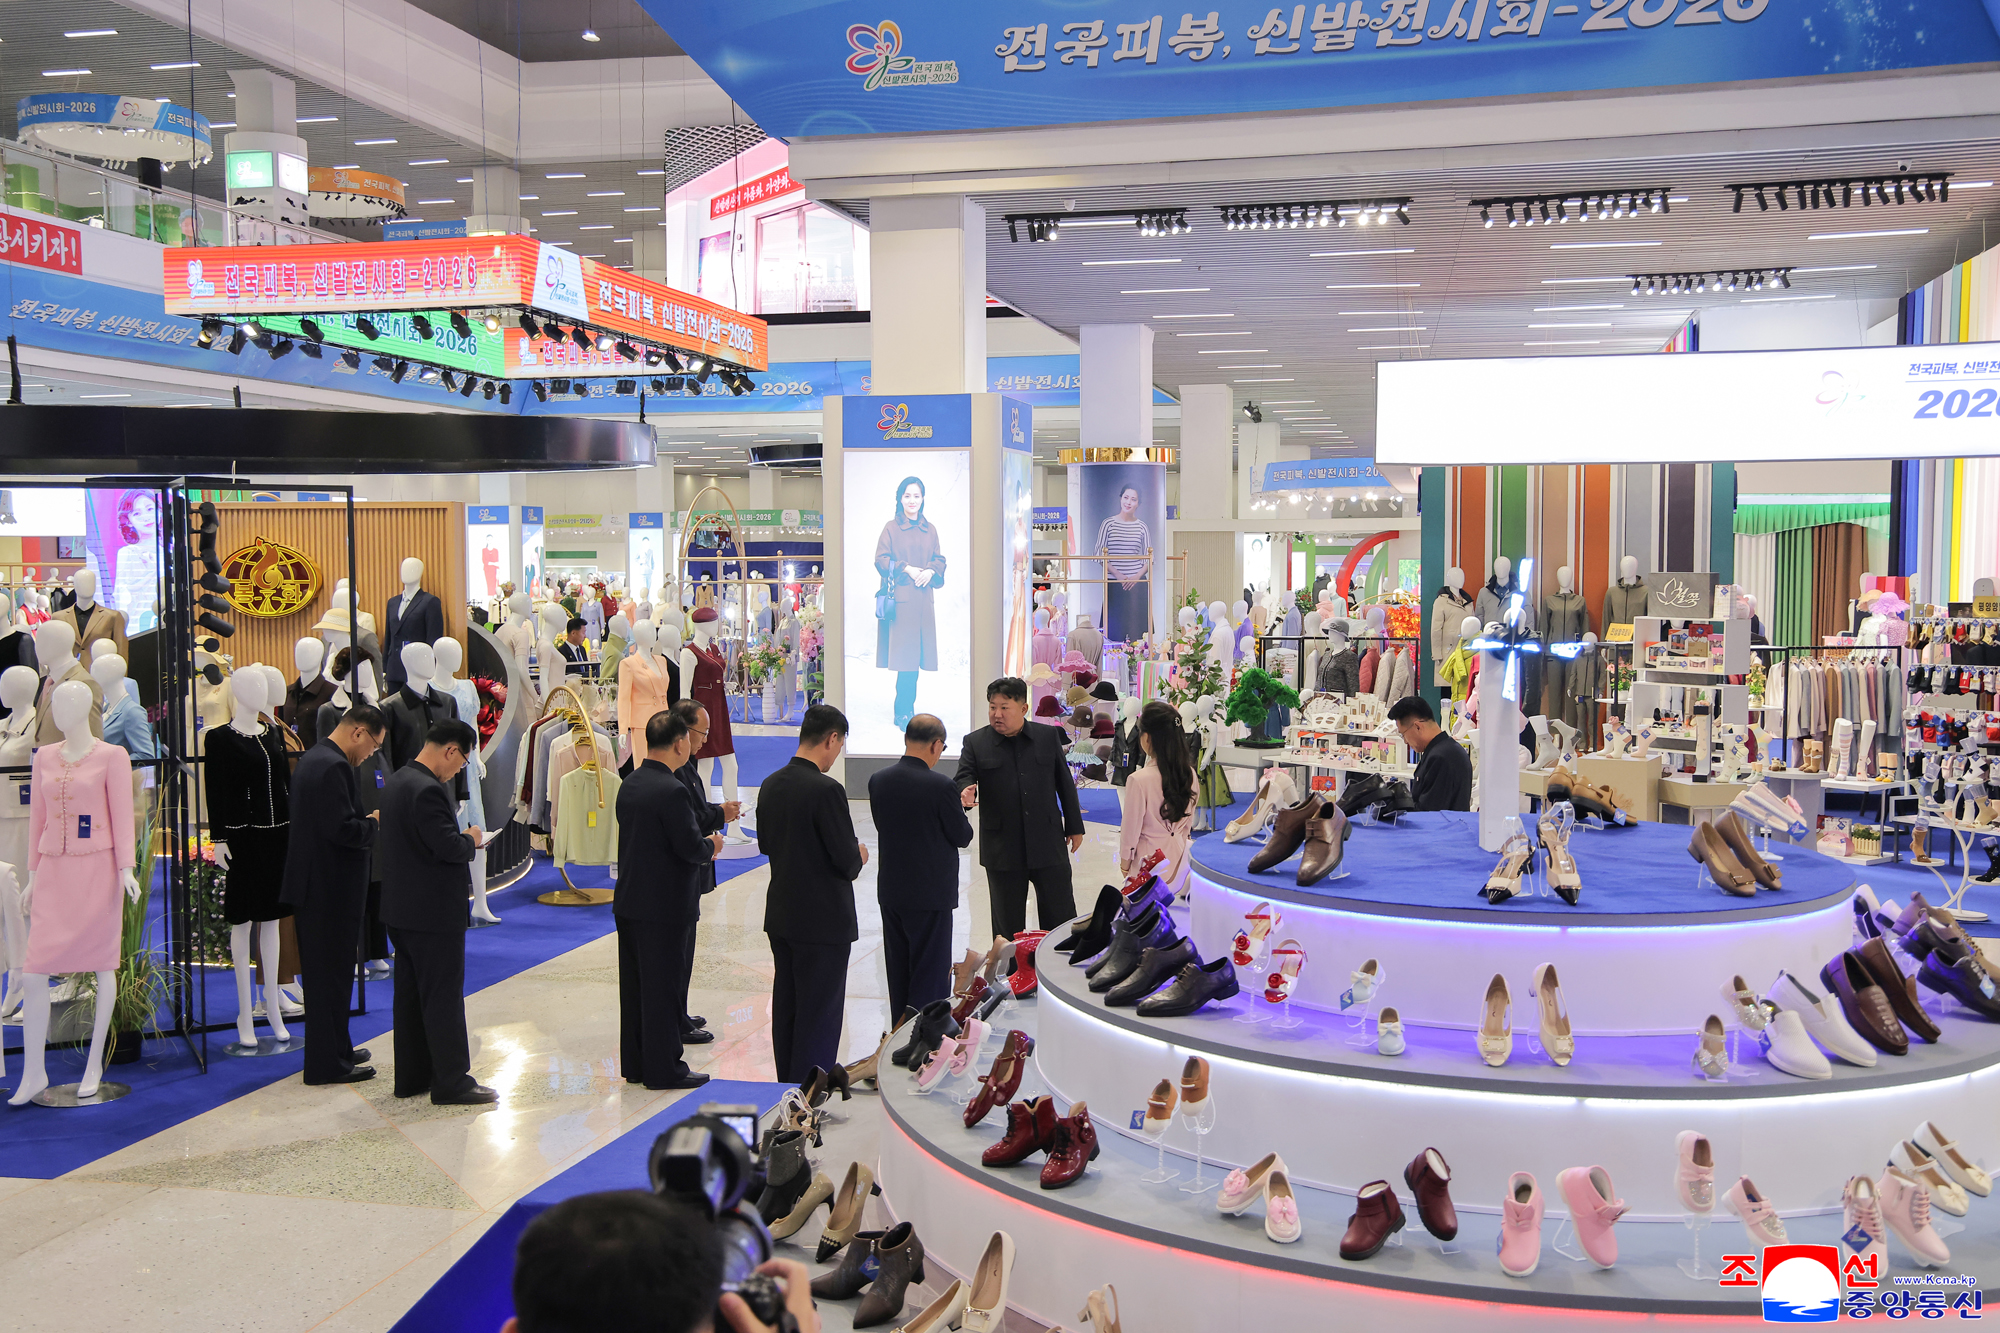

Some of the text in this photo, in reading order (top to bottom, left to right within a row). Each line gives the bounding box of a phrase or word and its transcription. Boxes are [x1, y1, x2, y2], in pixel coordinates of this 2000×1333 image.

[995, 11, 1232, 72] 전국피복,
[914, 62, 956, 73] 전국피복,
[26, 102, 97, 117] 신발전시회-2026
[418, 226, 467, 237] 신발전시회-202
[225, 254, 478, 297] 전국피복, 신발전시회-2026
[8, 298, 98, 330] 전국피복,
[598, 279, 657, 327] 전국피복,
[662, 300, 754, 353] 신발전시회-2026
[1908, 360, 2000, 376] 전국피복, 신발전
[1913, 388, 2000, 419] 202
[1273, 469, 1306, 482] 전국피복,
[1979, 602, 2000, 612] 평양양
